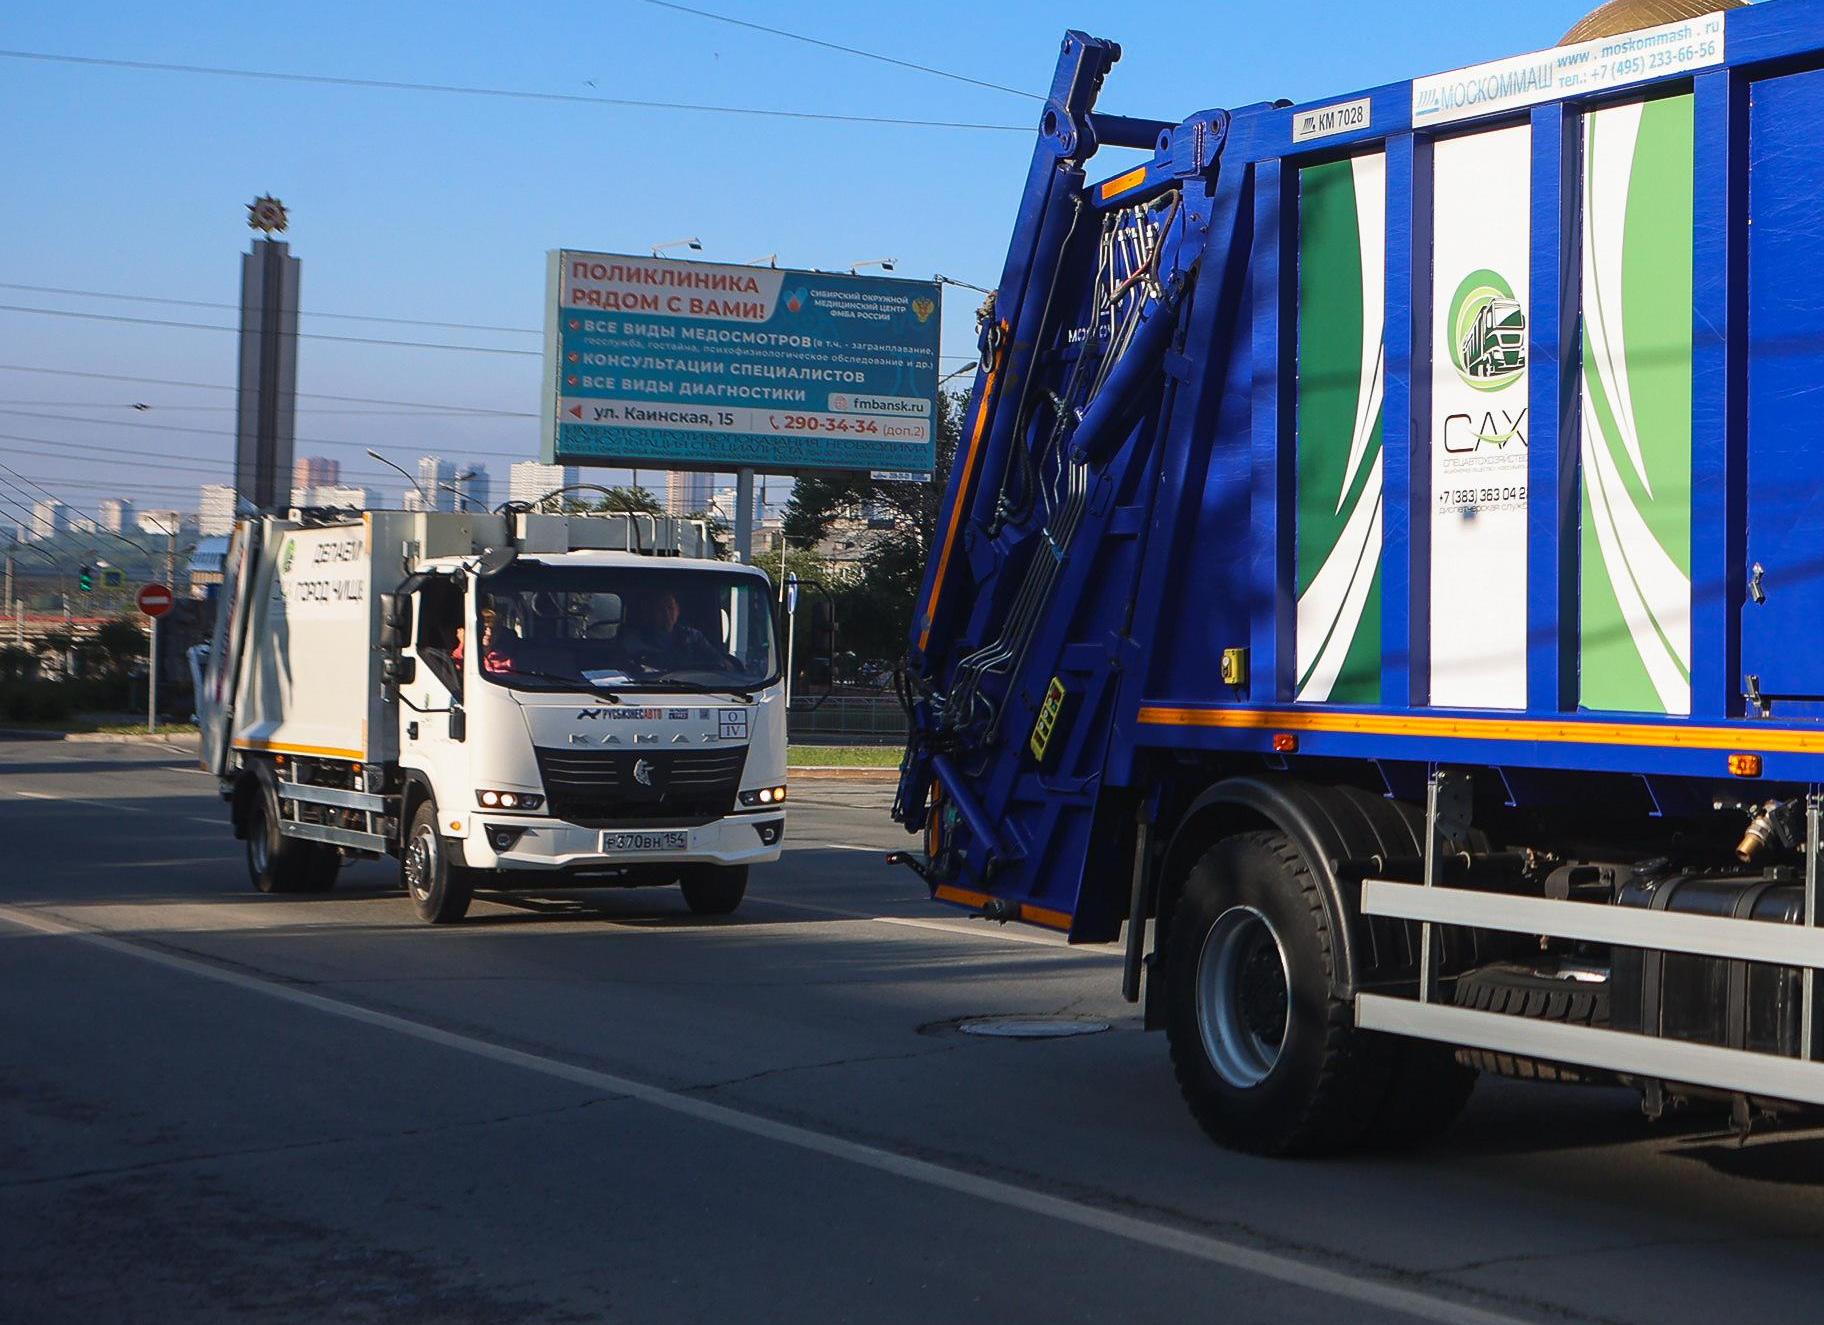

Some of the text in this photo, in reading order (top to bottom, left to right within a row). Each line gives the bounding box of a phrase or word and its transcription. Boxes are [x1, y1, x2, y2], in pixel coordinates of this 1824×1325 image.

[1557, 50, 1590, 68] www
[1600, 25, 1693, 59] moskommash
[1705, 21, 1720, 34] ru
[1591, 65, 1608, 82] +7
[1611, 56, 1645, 81] (495)
[1649, 40, 1716, 69] 233-66-56
[1441, 62, 1553, 111] МОСКОММАШ
[1319, 105, 1364, 131] КМ 7028
[572, 261, 760, 294] ПОЛИКЛИНИКА
[572, 288, 765, 320] РЯДОМ С ВАМИ!
[810, 289, 909, 305] СИБИРСКИЙ ОКРУЖНОЙ
[814, 299, 906, 313] МЕДИЦИНСКИЙ ЦЕНТР
[830, 310, 891, 321] ФМБА РОССИИ
[584, 320, 617, 334] ВСЕ
[623, 322, 675, 339] ВИДЫ
[681, 326, 811, 349] МЕДОСМОТРОВ
[583, 352, 865, 384] КОНСУЛЬТАЦИИ СПЕЦИАЛИСТОВ
[831, 353, 904, 368] обследование
[582, 375, 806, 401] ВСЕ ВИДЫ ДИАГНОСТИКИ
[593, 406, 734, 427] ул. Каинская, 15
[854, 398, 924, 413] fmbansk.ru
[783, 415, 925, 439] 290-34-34 (доп.2)
[1444, 407, 1529, 453] САХ
[1440, 490, 1450, 504] +7
[1452, 488, 1478, 505] (383)
[1479, 488, 1500, 502] 363
[1502, 487, 1517, 501] 04
[726, 725, 740, 736] IV
[607, 833, 662, 849] Р370ВН
[664, 833, 685, 845] 154
